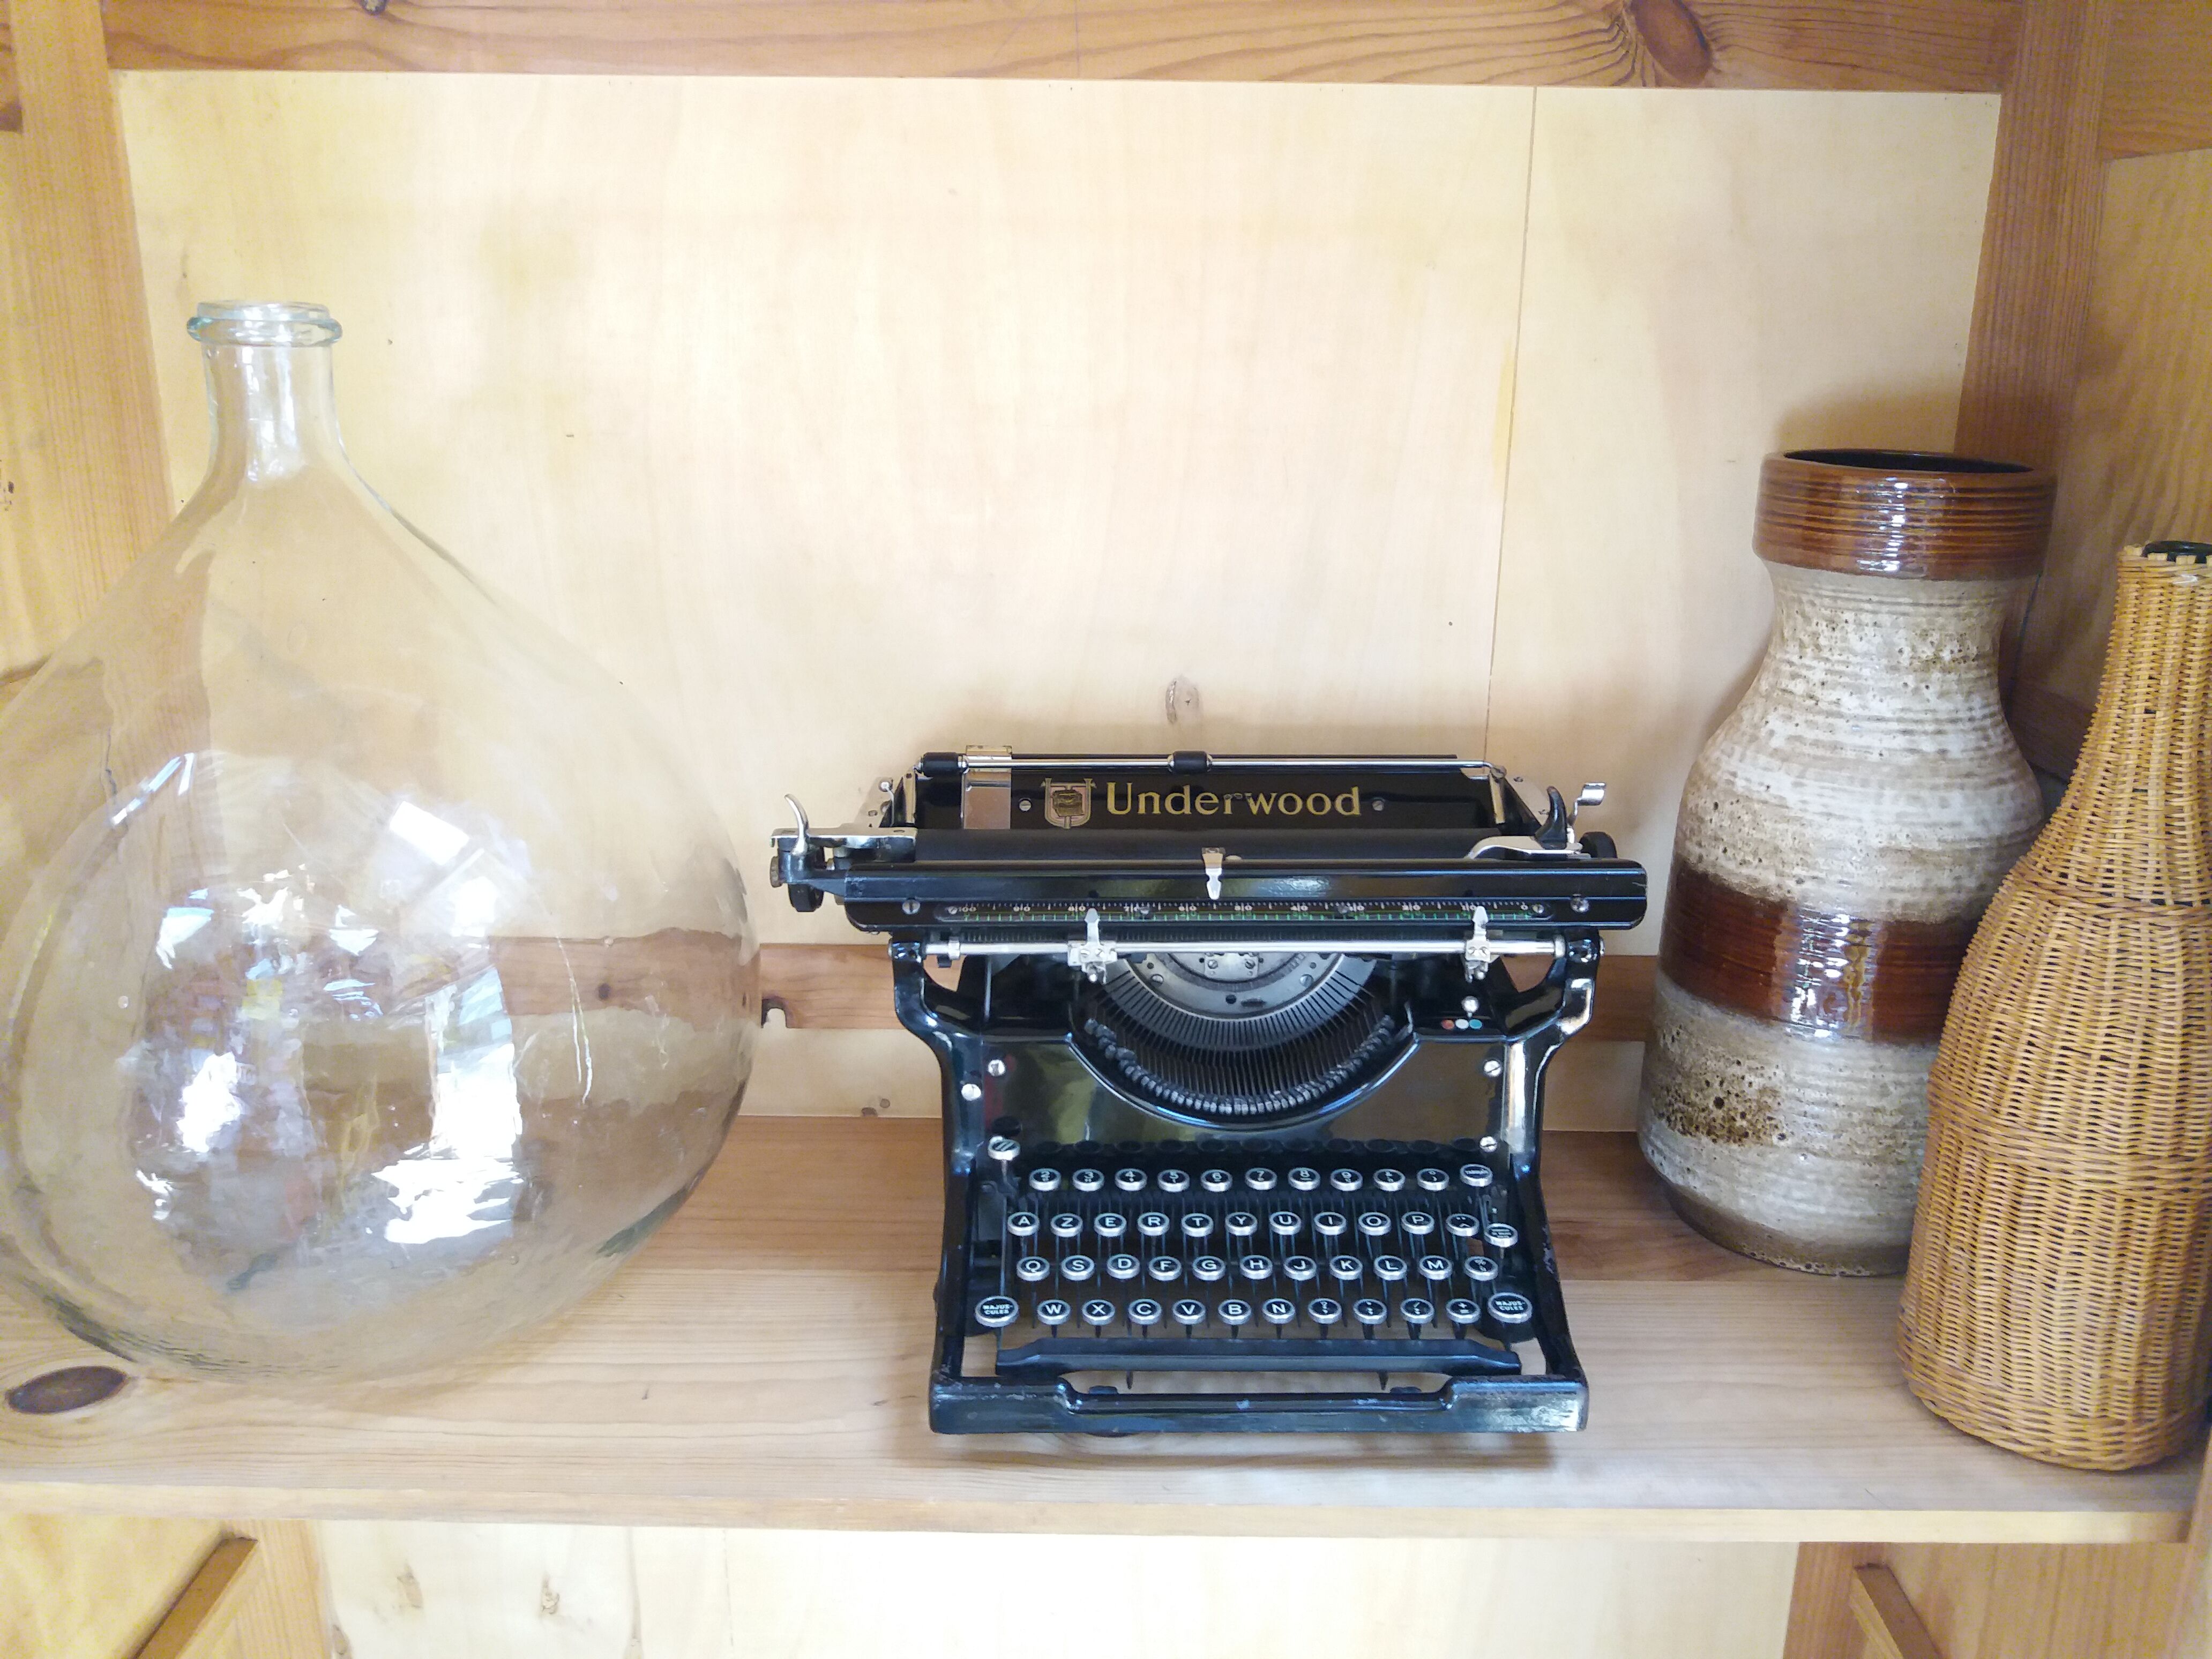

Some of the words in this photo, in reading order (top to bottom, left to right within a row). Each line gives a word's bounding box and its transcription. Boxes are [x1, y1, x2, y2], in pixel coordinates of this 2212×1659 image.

[1107, 781, 1361, 816] Underwood
[1085, 1171, 1094, 1179] 3
[1169, 1171, 1179, 1179] 5
[1018, 1216, 1030, 1225] A
[1060, 1217, 1073, 1227] Z
[1105, 1217, 1116, 1227] E
[1147, 1216, 1161, 1226] R
[1191, 1217, 1204, 1227] T
[1235, 1216, 1246, 1225] Y
[1278, 1215, 1293, 1225] U
[1366, 1216, 1382, 1226] O
[1411, 1215, 1424, 1224] P
[1025, 1260, 1041, 1273] Q
[1071, 1260, 1085, 1271] S
[1117, 1258, 1132, 1269] D
[1160, 1260, 1171, 1271] F
[1201, 1260, 1217, 1270] G
[1249, 1259, 1266, 1269] H
[1293, 1260, 1306, 1271] J
[1340, 1260, 1354, 1270] K
[1385, 1260, 1399, 1270] L
[1426, 1260, 1444, 1269] M
[1044, 1303, 1063, 1315] W
[1092, 1304, 1107, 1315] X
[1136, 1303, 1152, 1315] C
[1181, 1304, 1195, 1315] V
[1228, 1304, 1243, 1315] B
[1272, 1303, 1287, 1314] N
